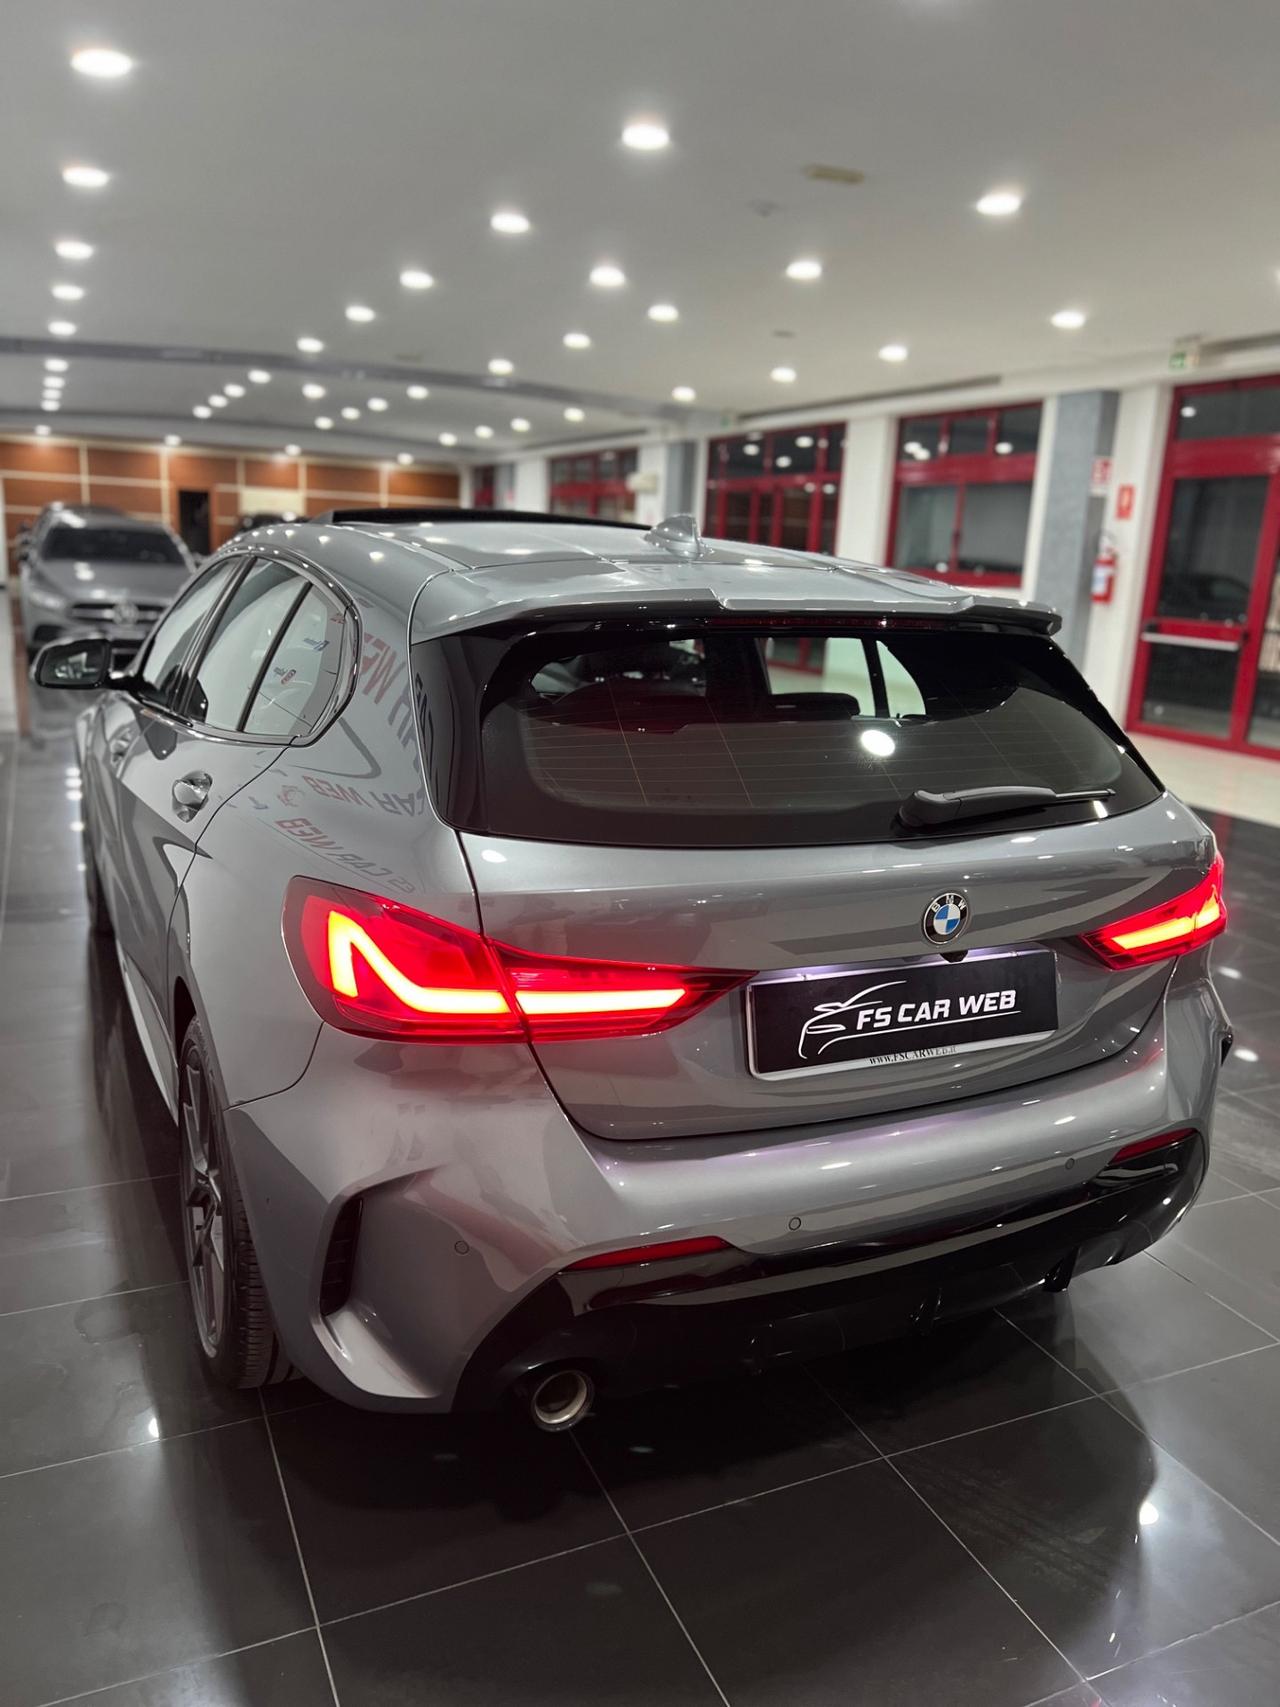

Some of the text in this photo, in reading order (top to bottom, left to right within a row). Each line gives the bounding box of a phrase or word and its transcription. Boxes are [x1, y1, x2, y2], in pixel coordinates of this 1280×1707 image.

[856, 989, 1017, 1031] FS CAR WEB
